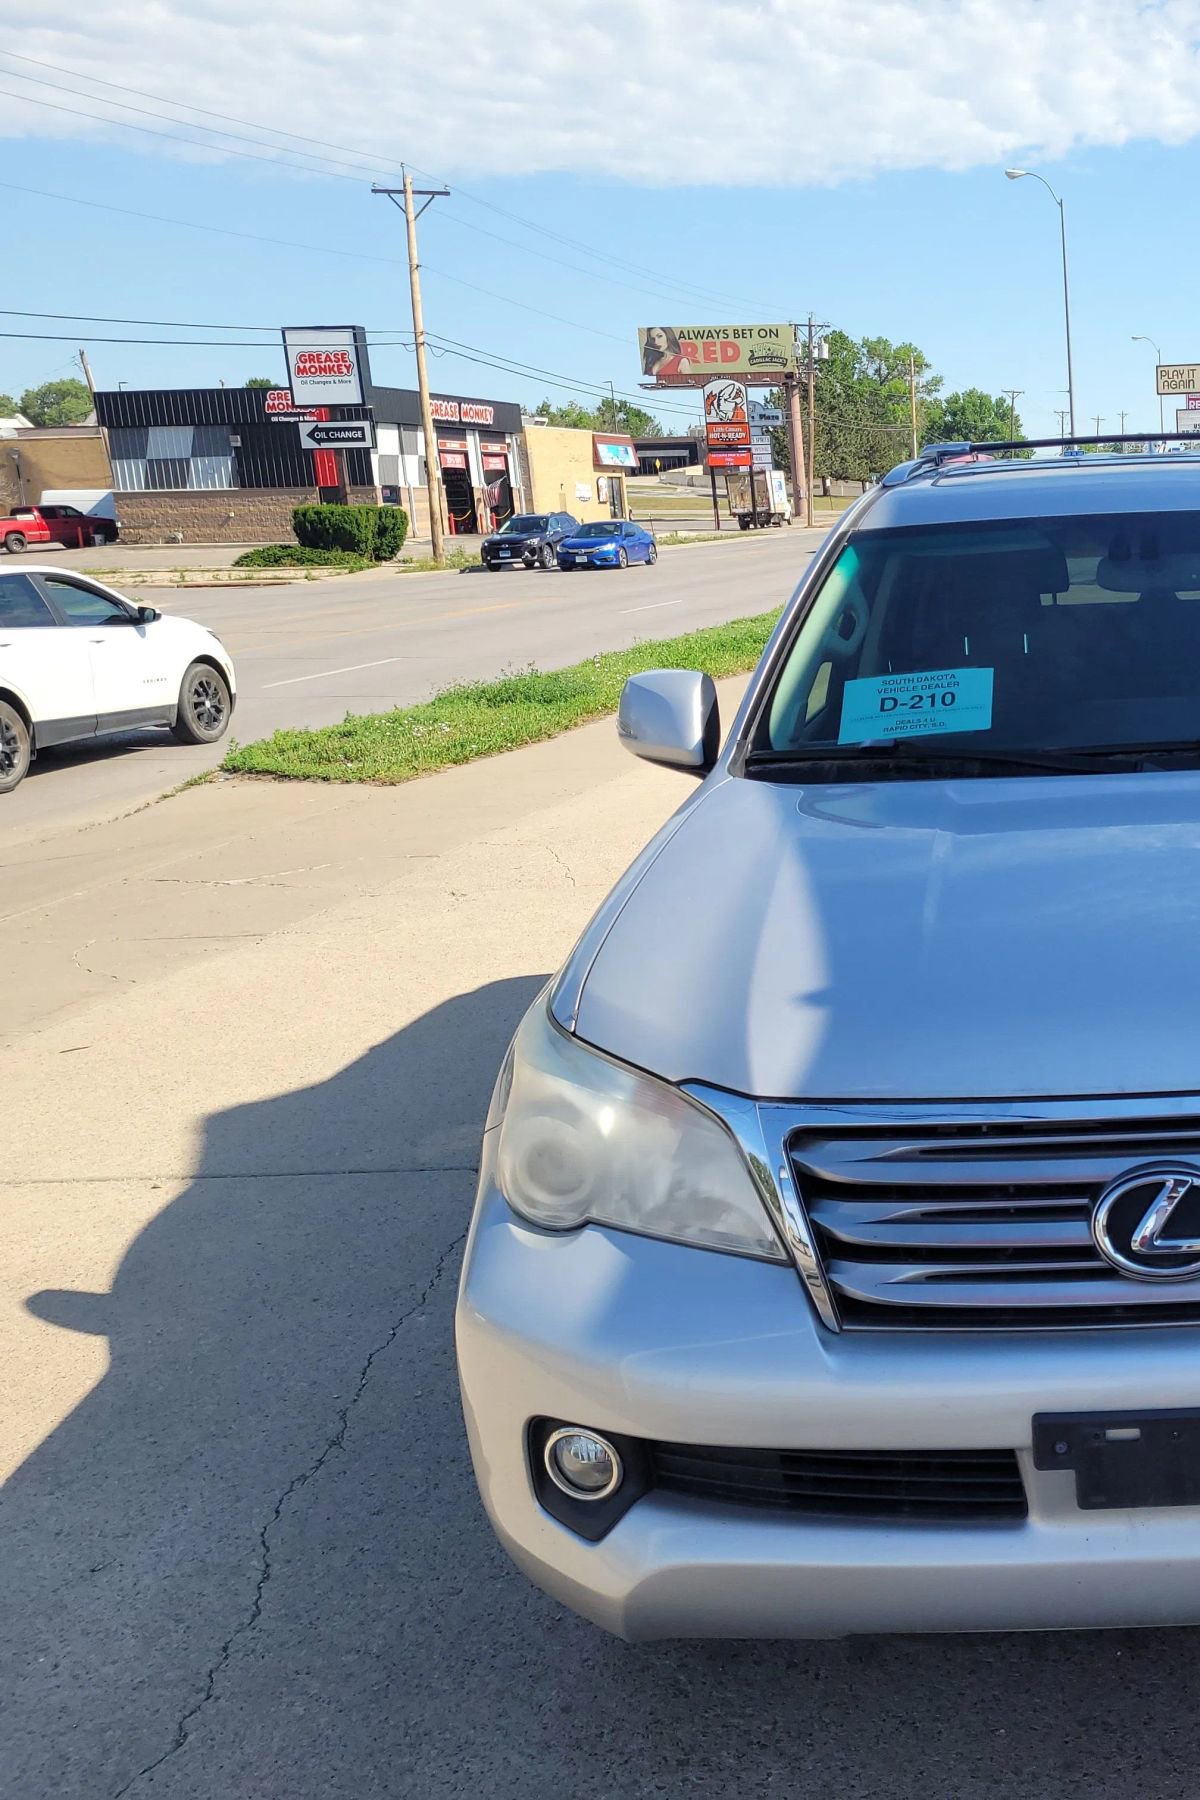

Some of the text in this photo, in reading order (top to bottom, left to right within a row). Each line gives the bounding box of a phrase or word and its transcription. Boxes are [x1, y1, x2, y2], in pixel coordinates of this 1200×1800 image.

[678, 328, 779, 341] ALWAYS BET ON
[298, 351, 349, 364] GREASE
[680, 340, 741, 365] RED
[296, 363, 353, 376] MONKEY
[1160, 368, 1196, 380] PLAY IT
[1162, 379, 1195, 390] AGAIN
[461, 403, 494, 424] MONKEY
[314, 430, 363, 439] OIL CHANGE
[881, 673, 956, 686] SOUTH DAKOTA
[877, 681, 960, 695] VEHICLE DEALER
[879, 691, 956, 713] D-210
